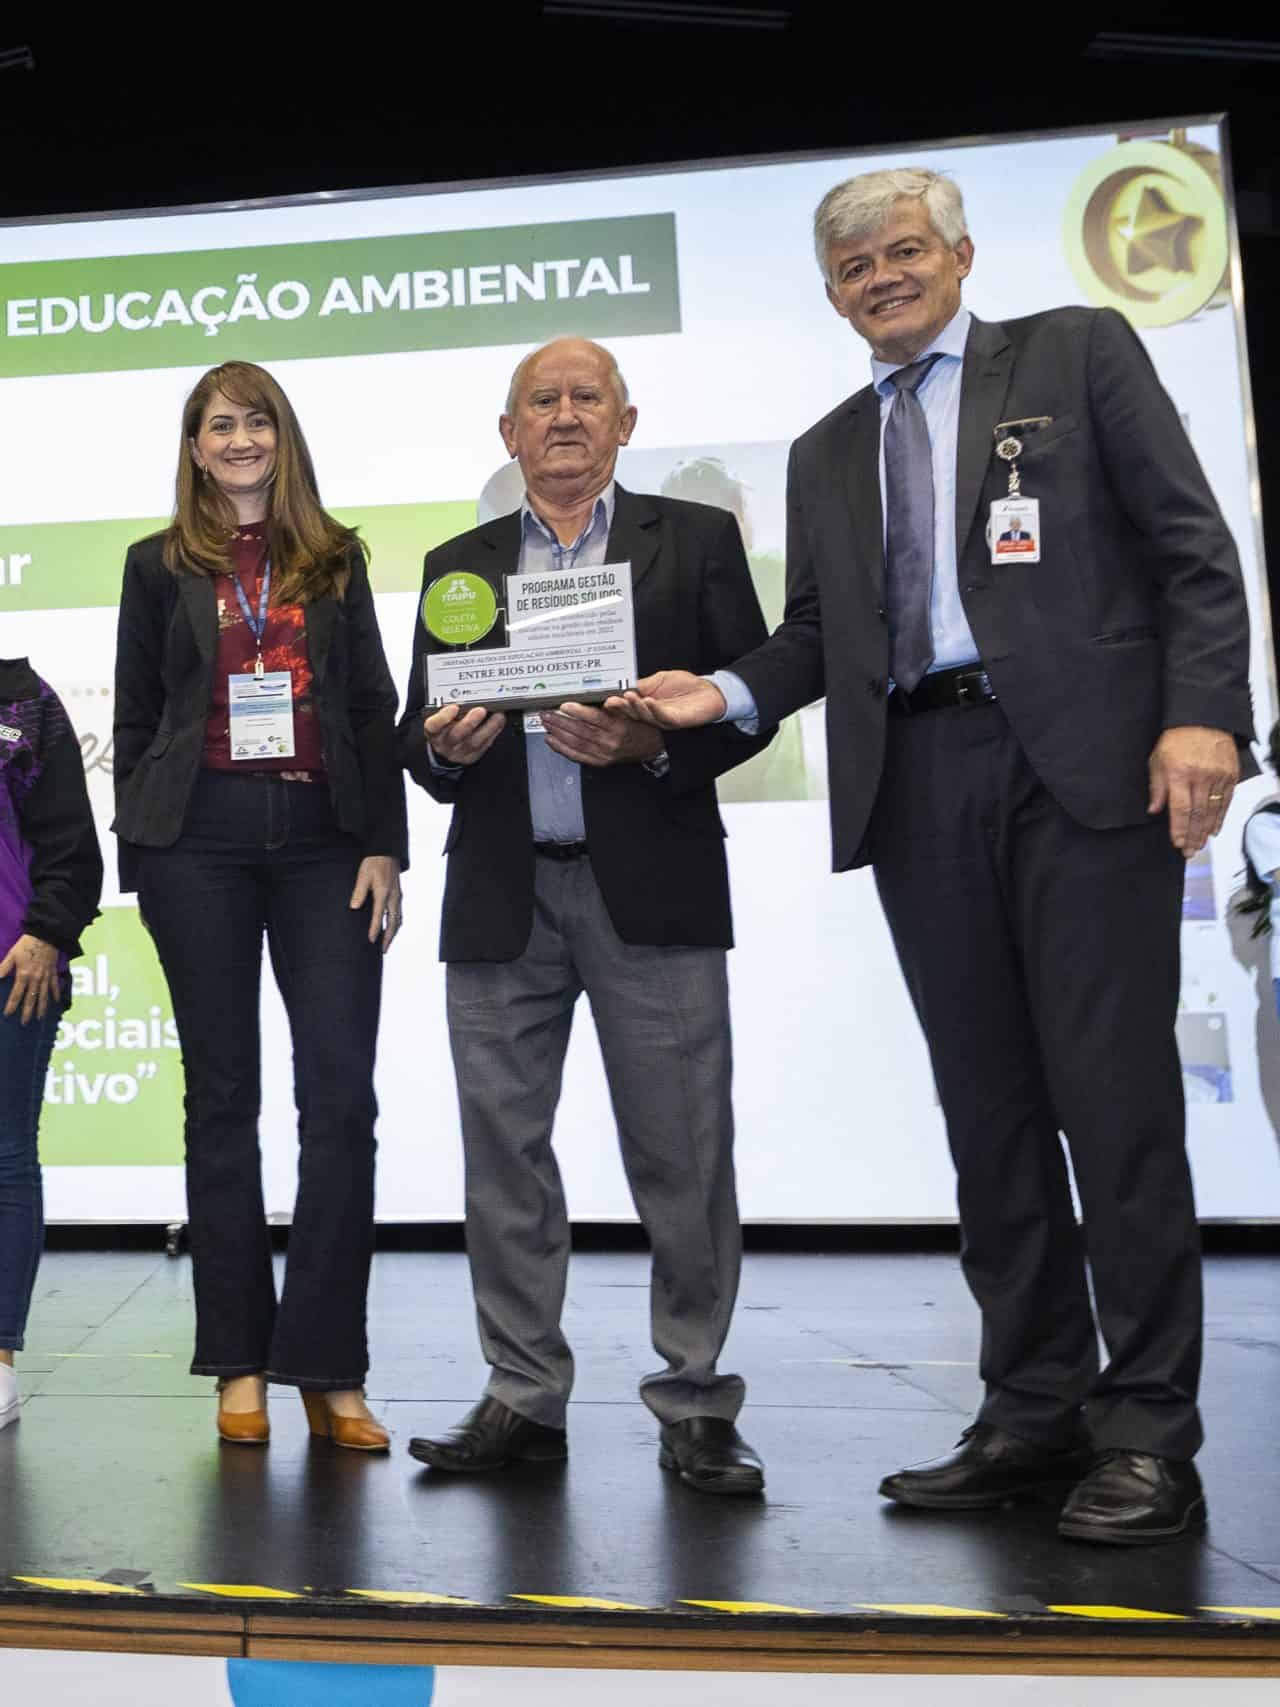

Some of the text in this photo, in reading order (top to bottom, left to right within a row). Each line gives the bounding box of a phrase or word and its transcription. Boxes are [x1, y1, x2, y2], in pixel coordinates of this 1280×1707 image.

[6, 274, 311, 336] EDUCAÇÃO
[318, 255, 651, 316] AMBIENTAL
[521, 572, 616, 594] PROGRAMA GESTÃO
[516, 599, 529, 611] DE
[531, 592, 579, 609] RESÍDUOS
[458, 658, 602, 681] ENTRE RIOS DO OESTE-PR
[53, 1005, 181, 1050] ociais
